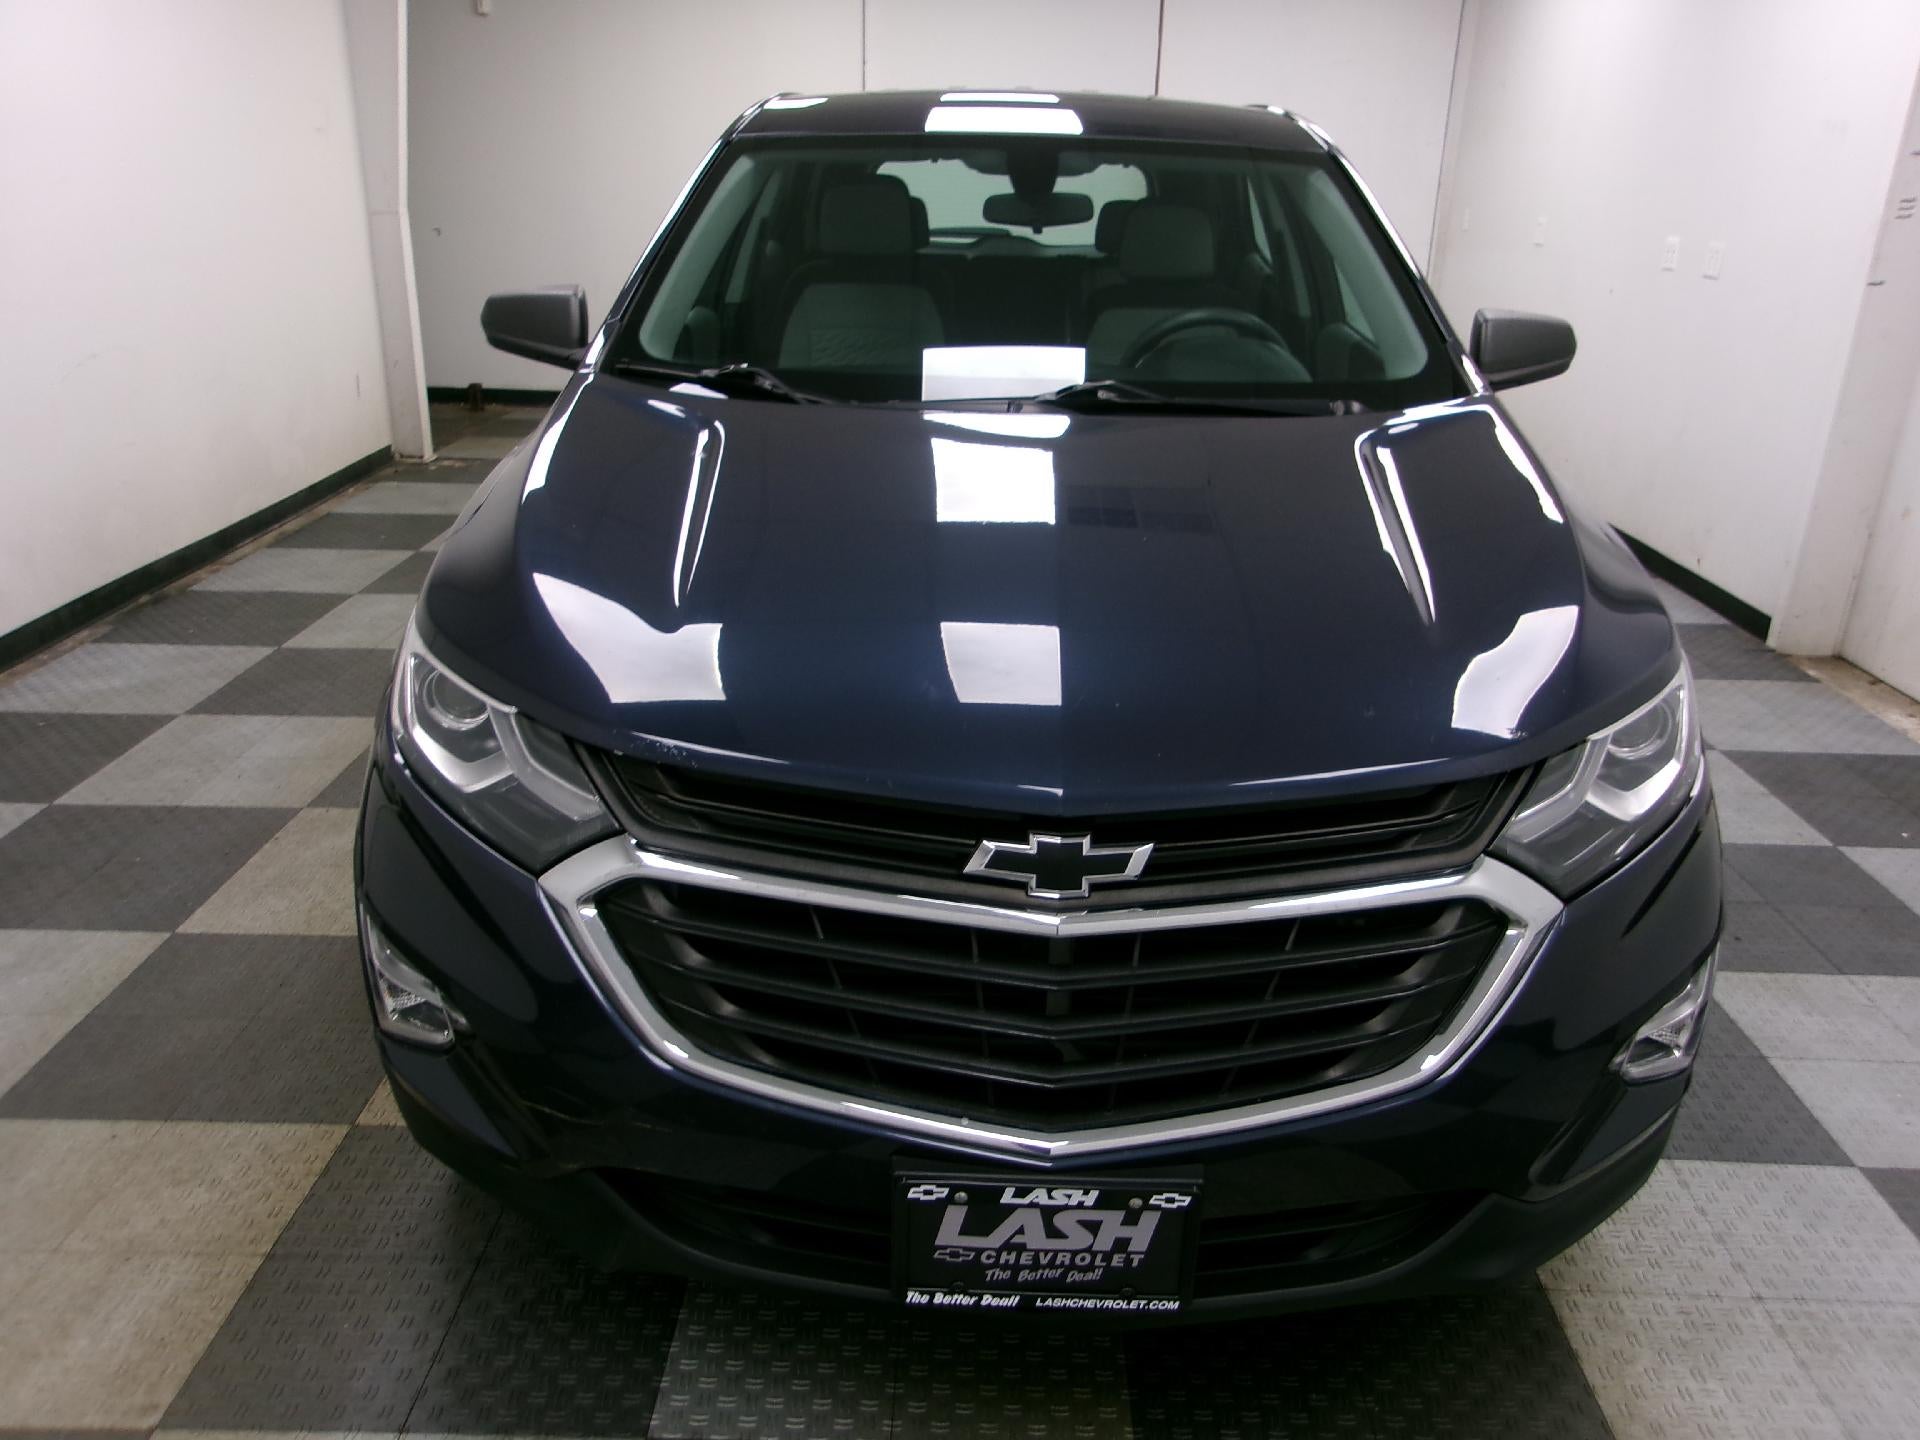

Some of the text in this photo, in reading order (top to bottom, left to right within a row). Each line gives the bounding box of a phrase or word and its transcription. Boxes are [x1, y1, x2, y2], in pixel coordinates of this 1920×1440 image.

[1000, 1187, 1100, 1206] LASH
[935, 1205, 1161, 1252] LASH
[981, 1251, 1144, 1267] CHEVROLET
[985, 1267, 1103, 1283] The Better Deal!
[905, 1291, 1019, 1308] The Better Deal!
[1036, 1297, 1180, 1310] LASHCHEVROLET.COM
